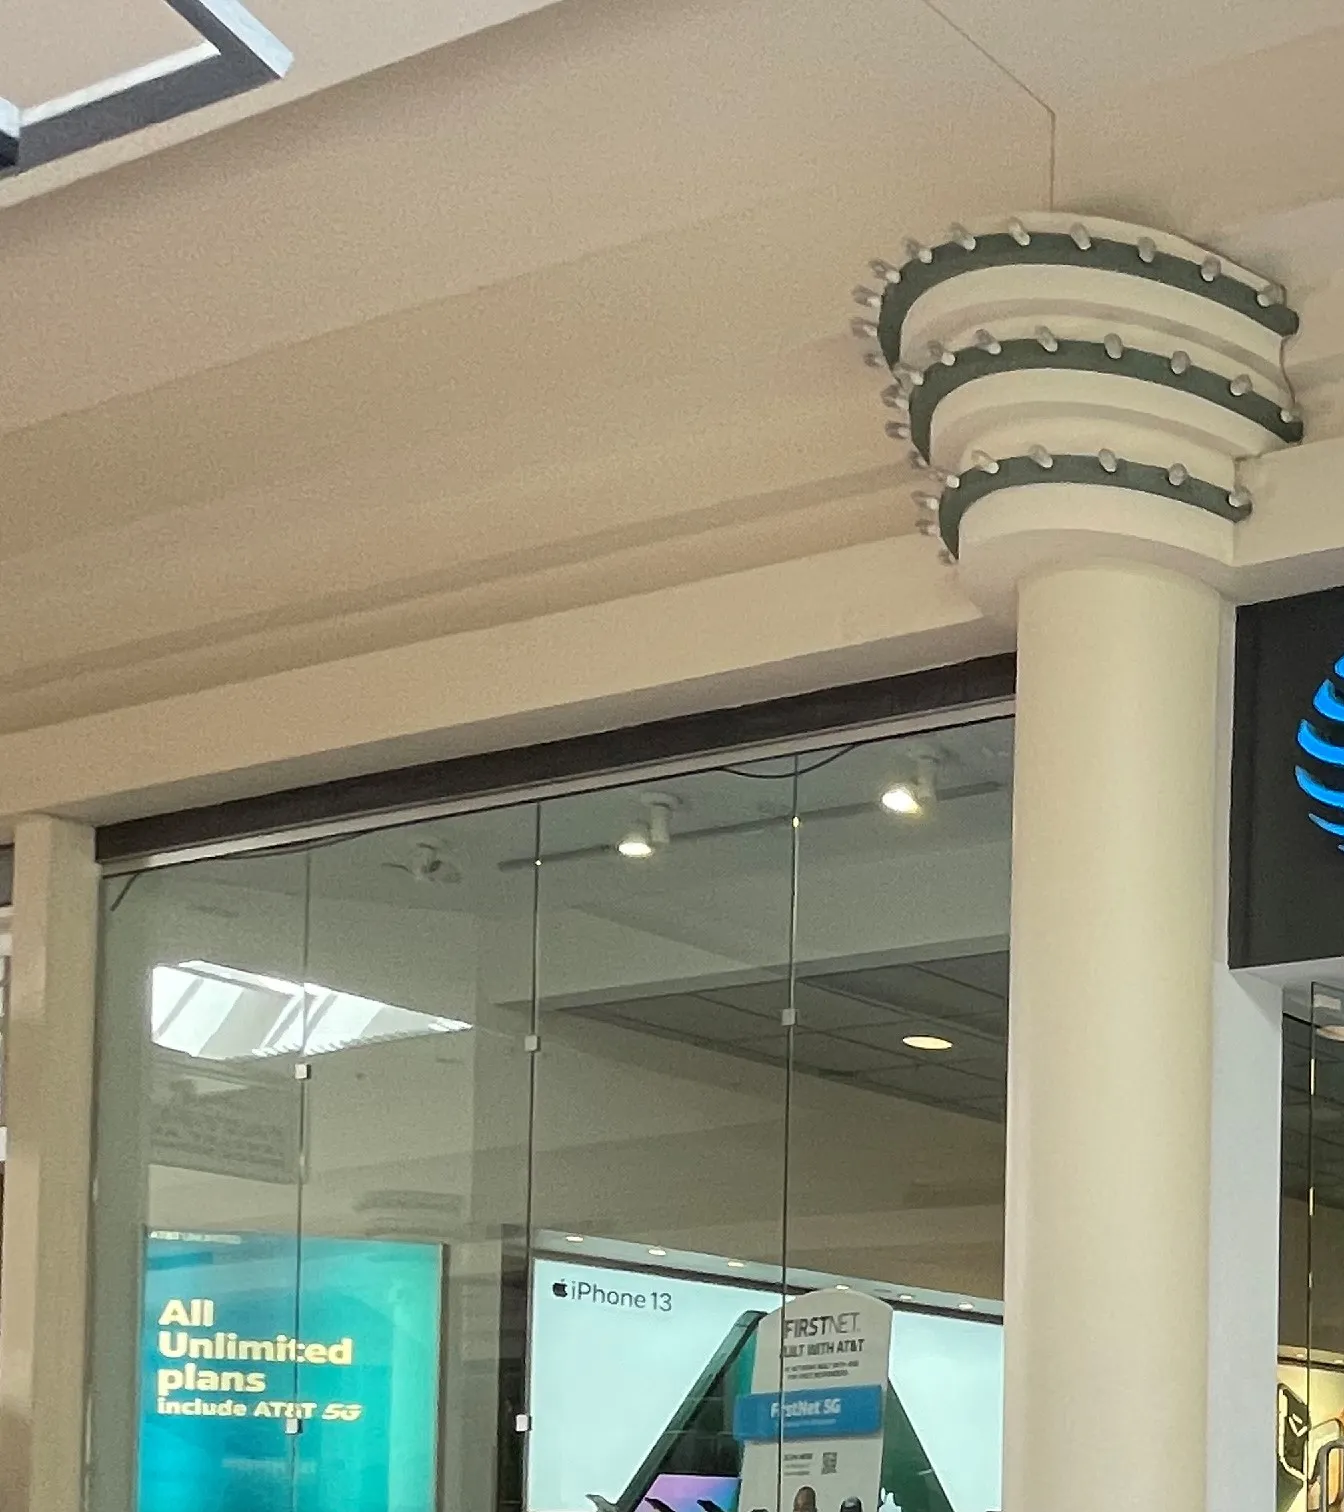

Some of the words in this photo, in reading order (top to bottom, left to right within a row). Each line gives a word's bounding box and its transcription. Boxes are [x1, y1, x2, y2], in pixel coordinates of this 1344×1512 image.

[571, 1281, 647, 1308] iPhone
[651, 1292, 673, 1312] 13
[158, 1299, 214, 1327] All
[158, 1331, 354, 1365] Unlimited
[157, 1363, 267, 1397] plans
[157, 1398, 248, 1416] include
